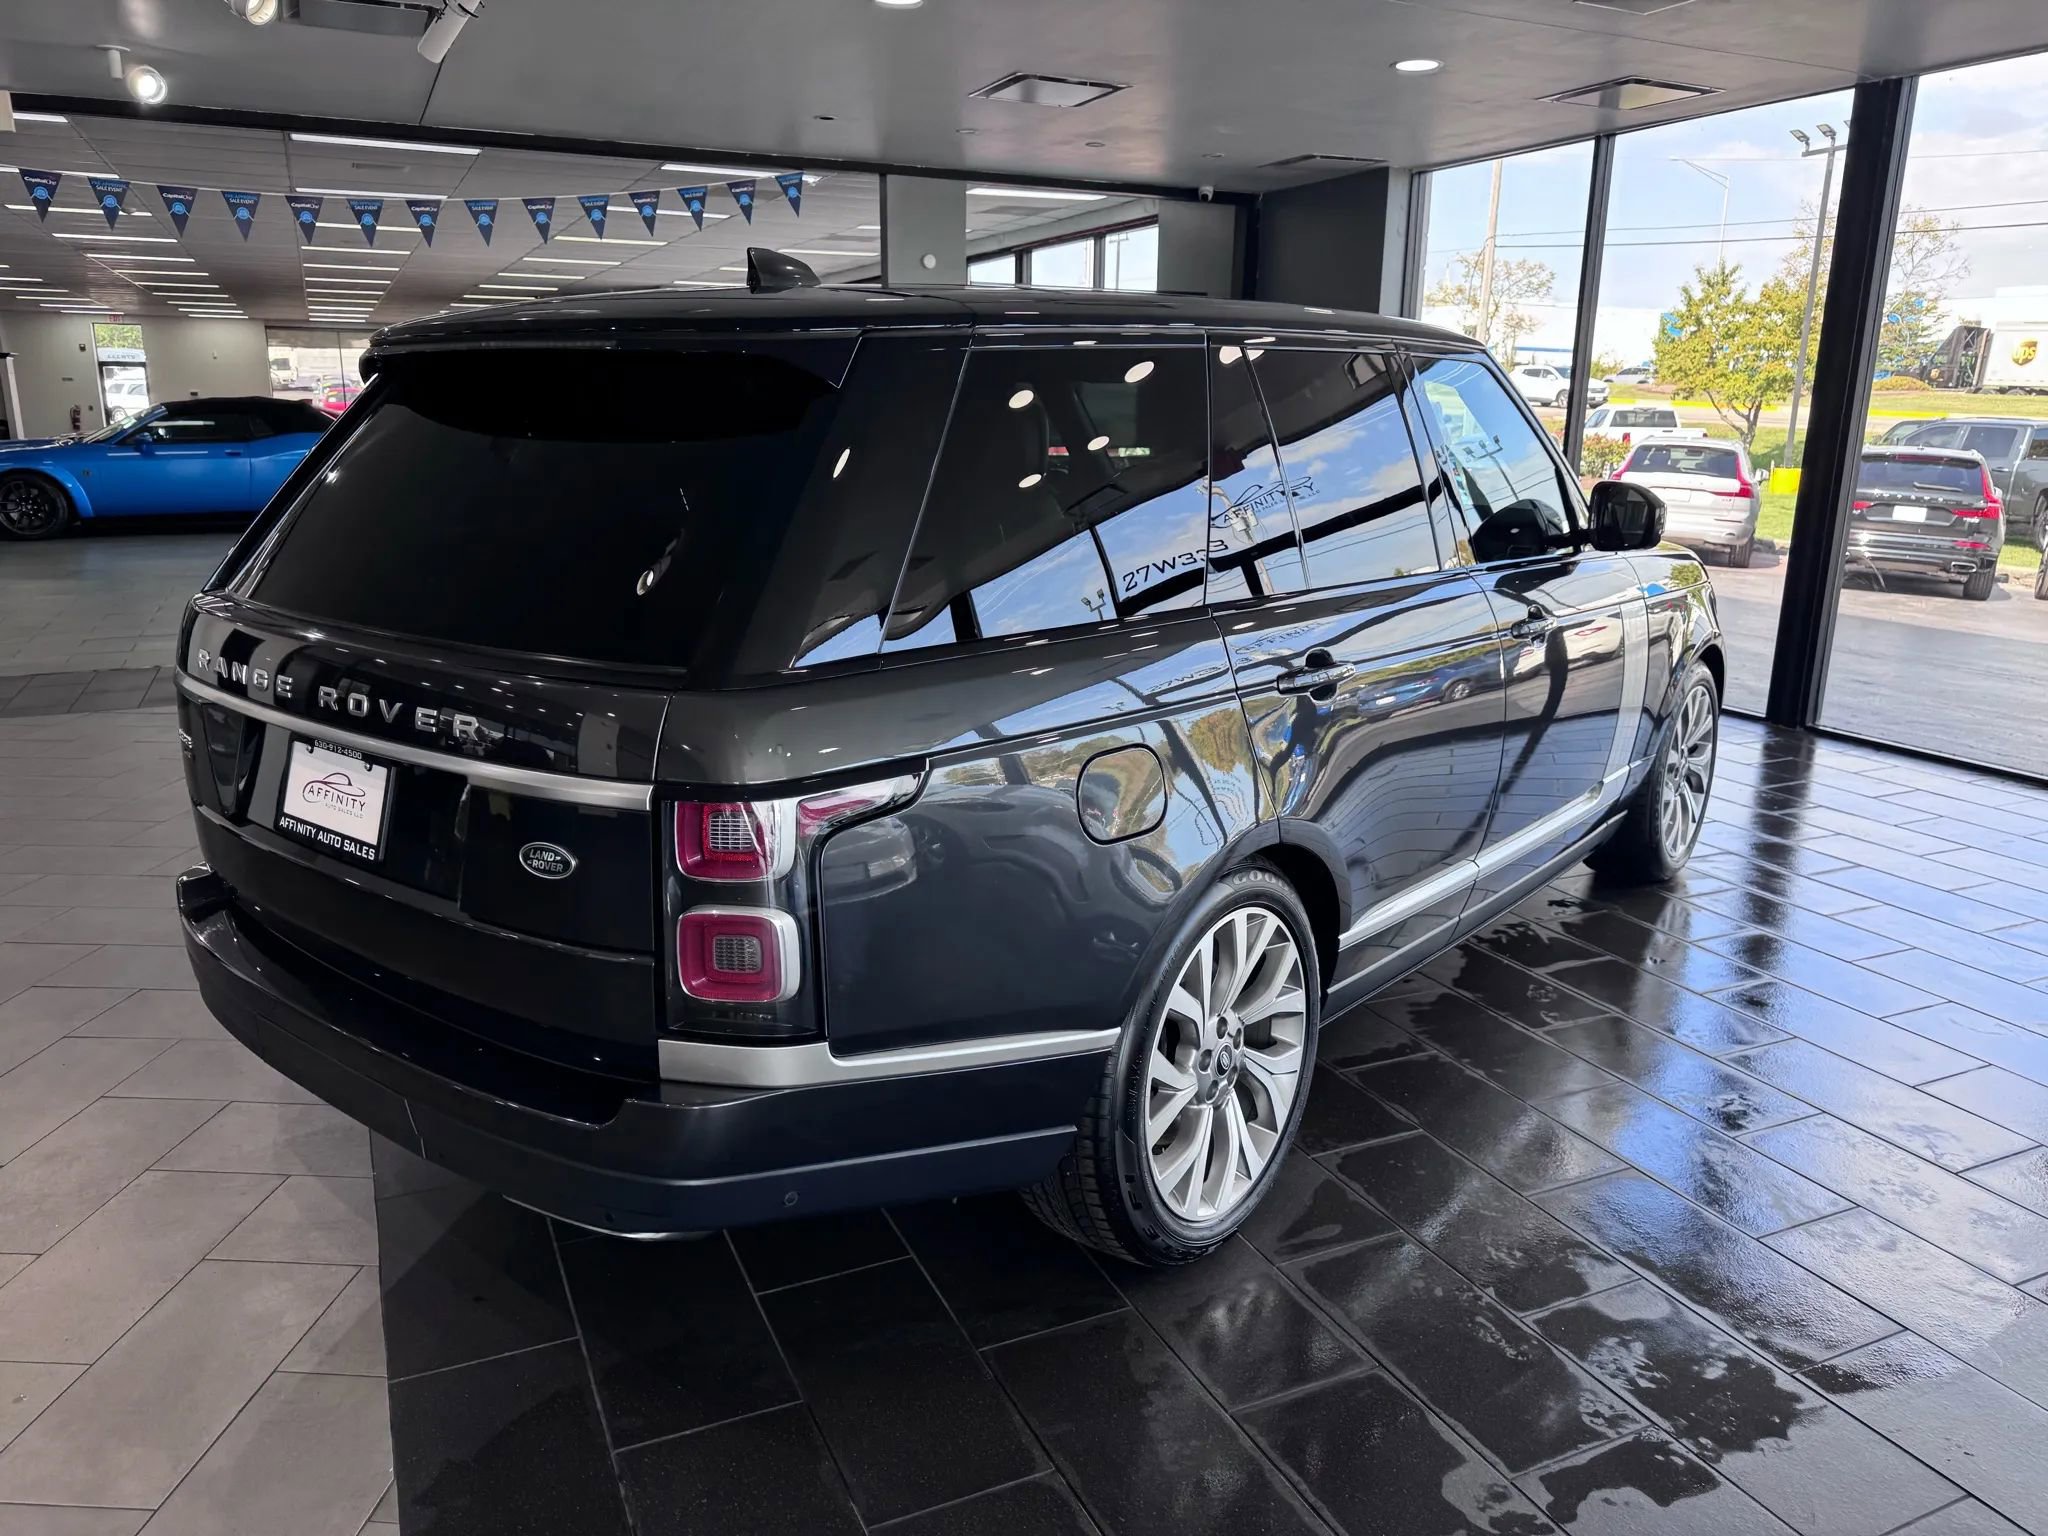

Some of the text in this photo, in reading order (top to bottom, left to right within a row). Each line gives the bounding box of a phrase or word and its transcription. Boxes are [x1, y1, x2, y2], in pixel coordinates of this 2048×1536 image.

[198, 648, 480, 741] RANGE ROVER
[307, 785, 366, 811] AFFINITY
[279, 816, 376, 861] AFFINITY AUTO SALES
